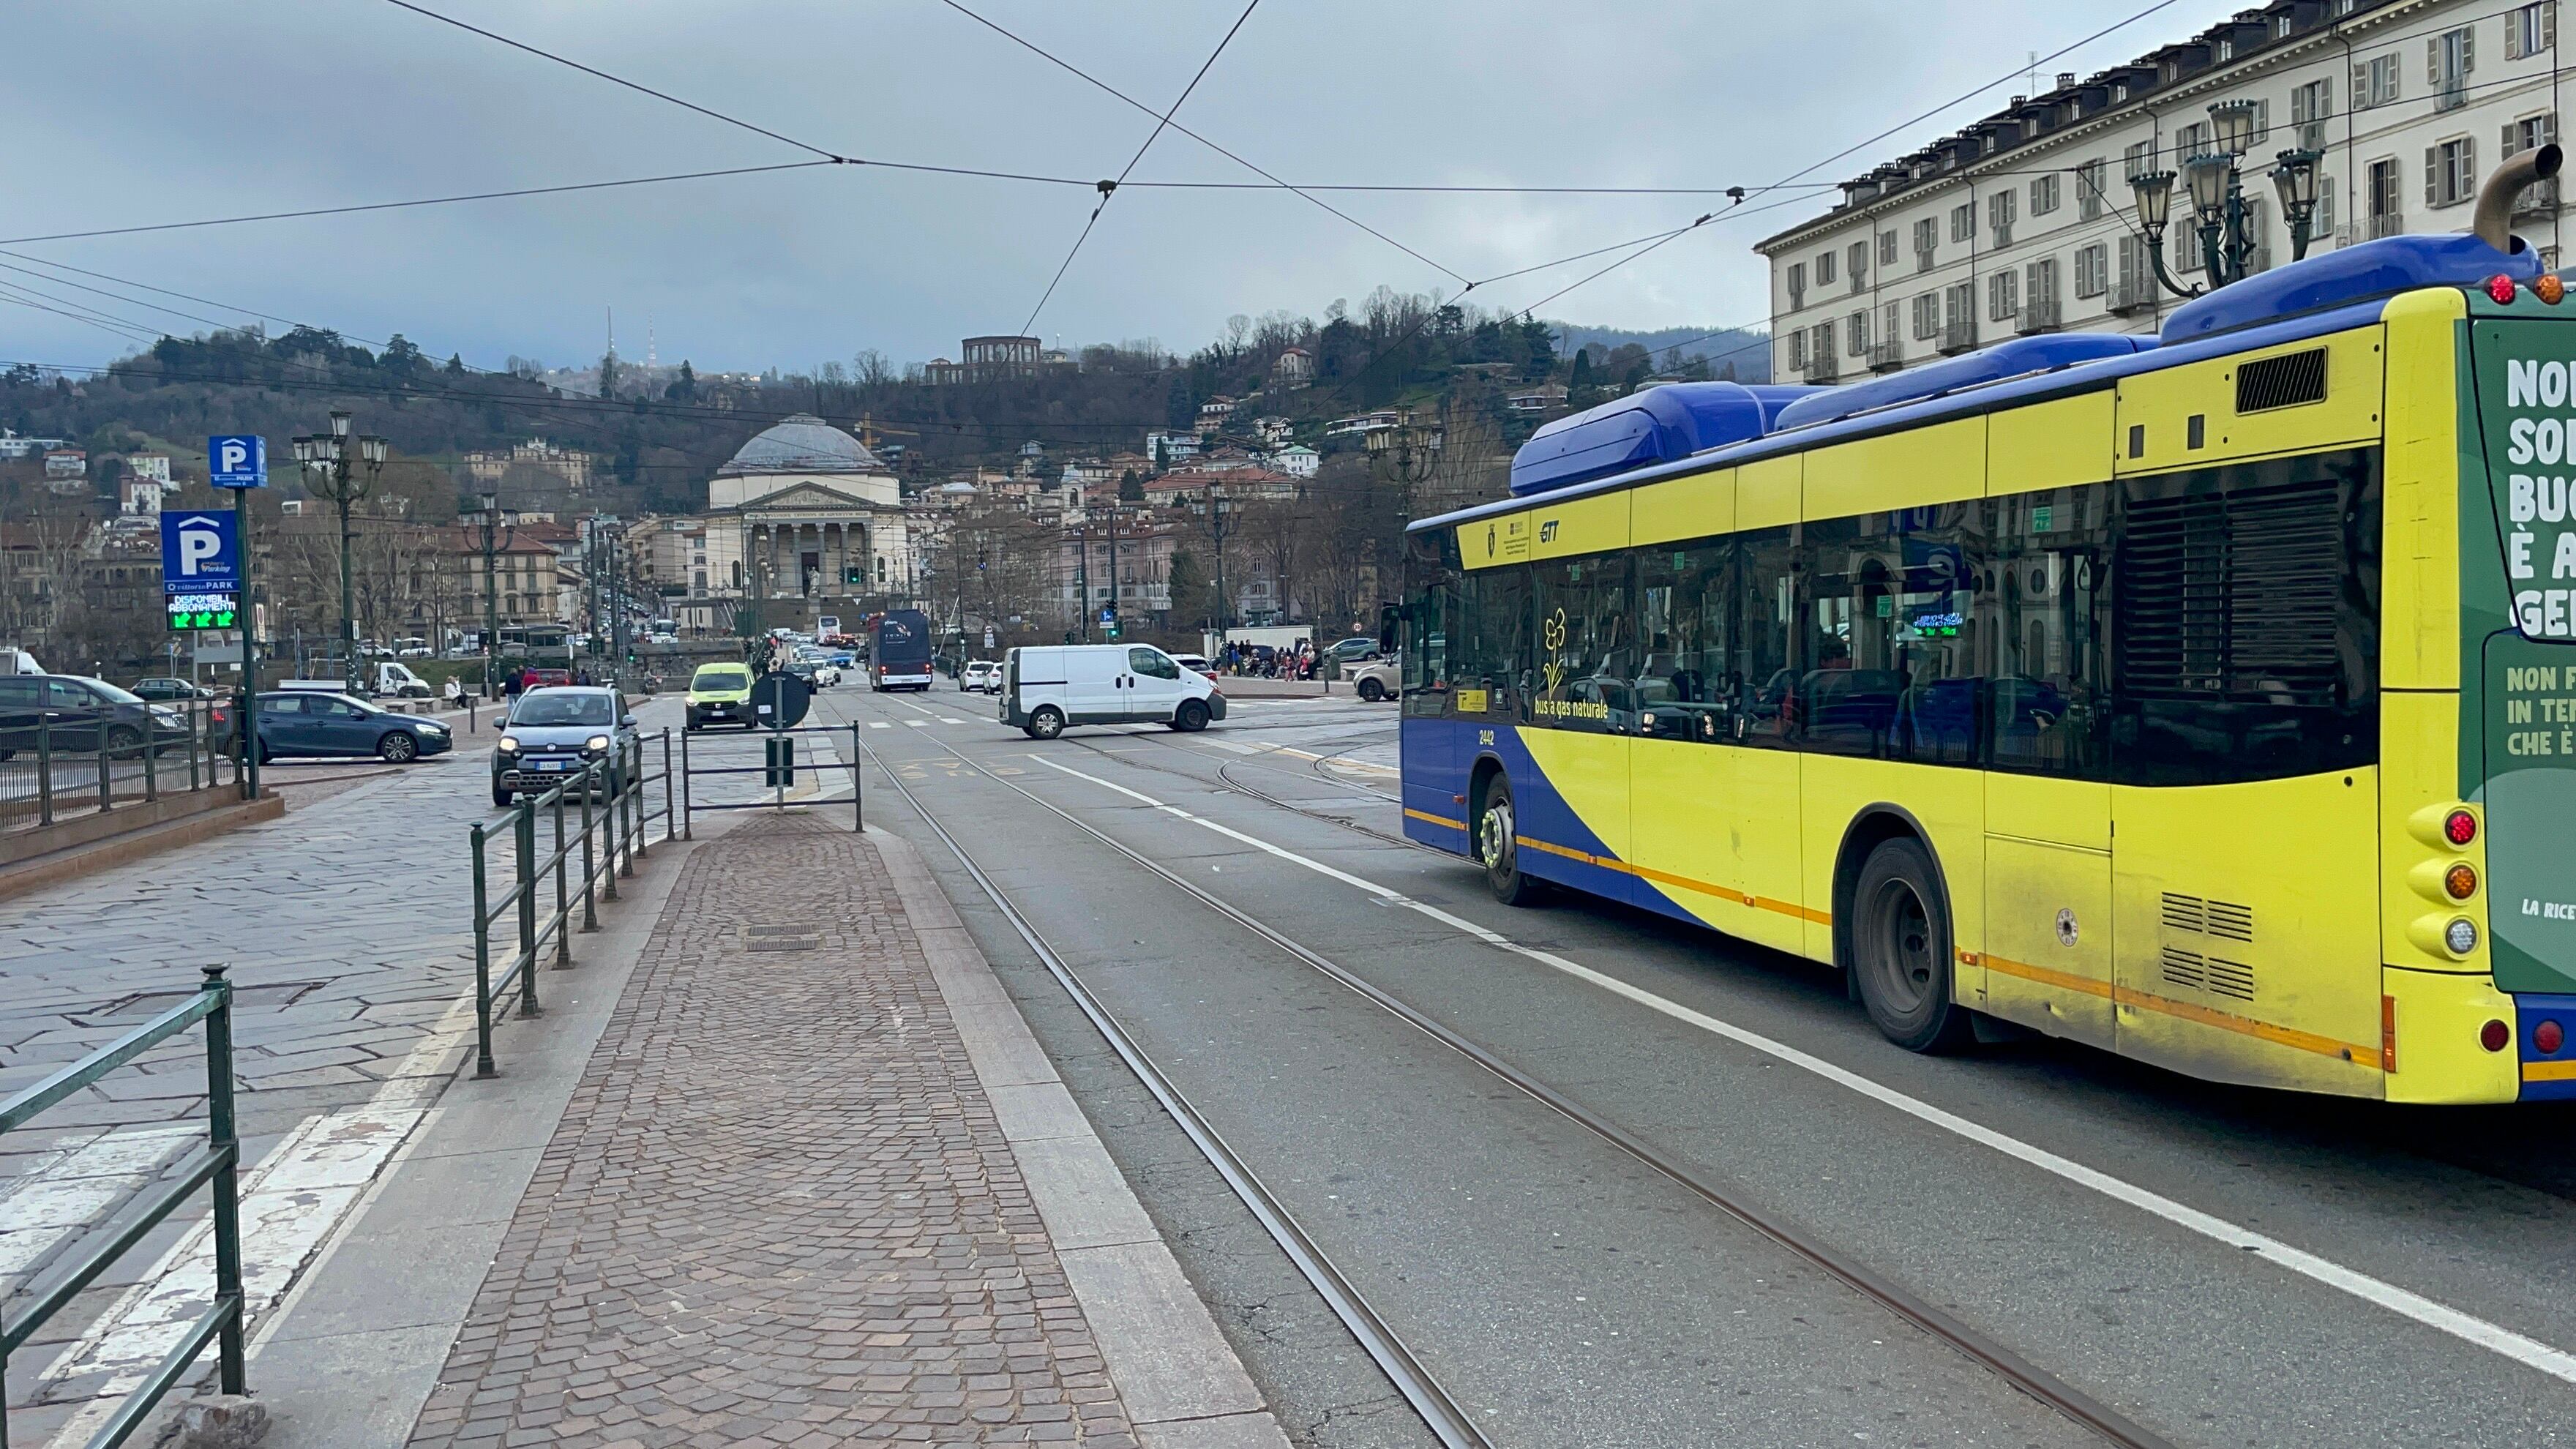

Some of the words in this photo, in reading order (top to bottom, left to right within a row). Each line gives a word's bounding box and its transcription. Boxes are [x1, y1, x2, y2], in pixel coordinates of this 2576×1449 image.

[2508, 359, 2576, 408] NO
[222, 446, 246, 472] P
[1540, 520, 1560, 543] GTT
[180, 530, 221, 575] P
[2510, 523, 2534, 579] È
[168, 602, 236, 613] ABBONAMENTI
[175, 594, 229, 604] DISPONIBILI
[2509, 589, 2576, 637] GE
[2507, 667, 2556, 692] NON
[1535, 695, 1548, 714] bus
[1550, 701, 1555, 714] a
[1557, 700, 1570, 719] gas
[1573, 697, 1609, 719] naturale
[2507, 700, 2531, 724] IN
[1480, 730, 1494, 745] 2442
[2508, 732, 2552, 755] CHE
[2561, 724, 2573, 755] È
[2522, 899, 2539, 916] LA
